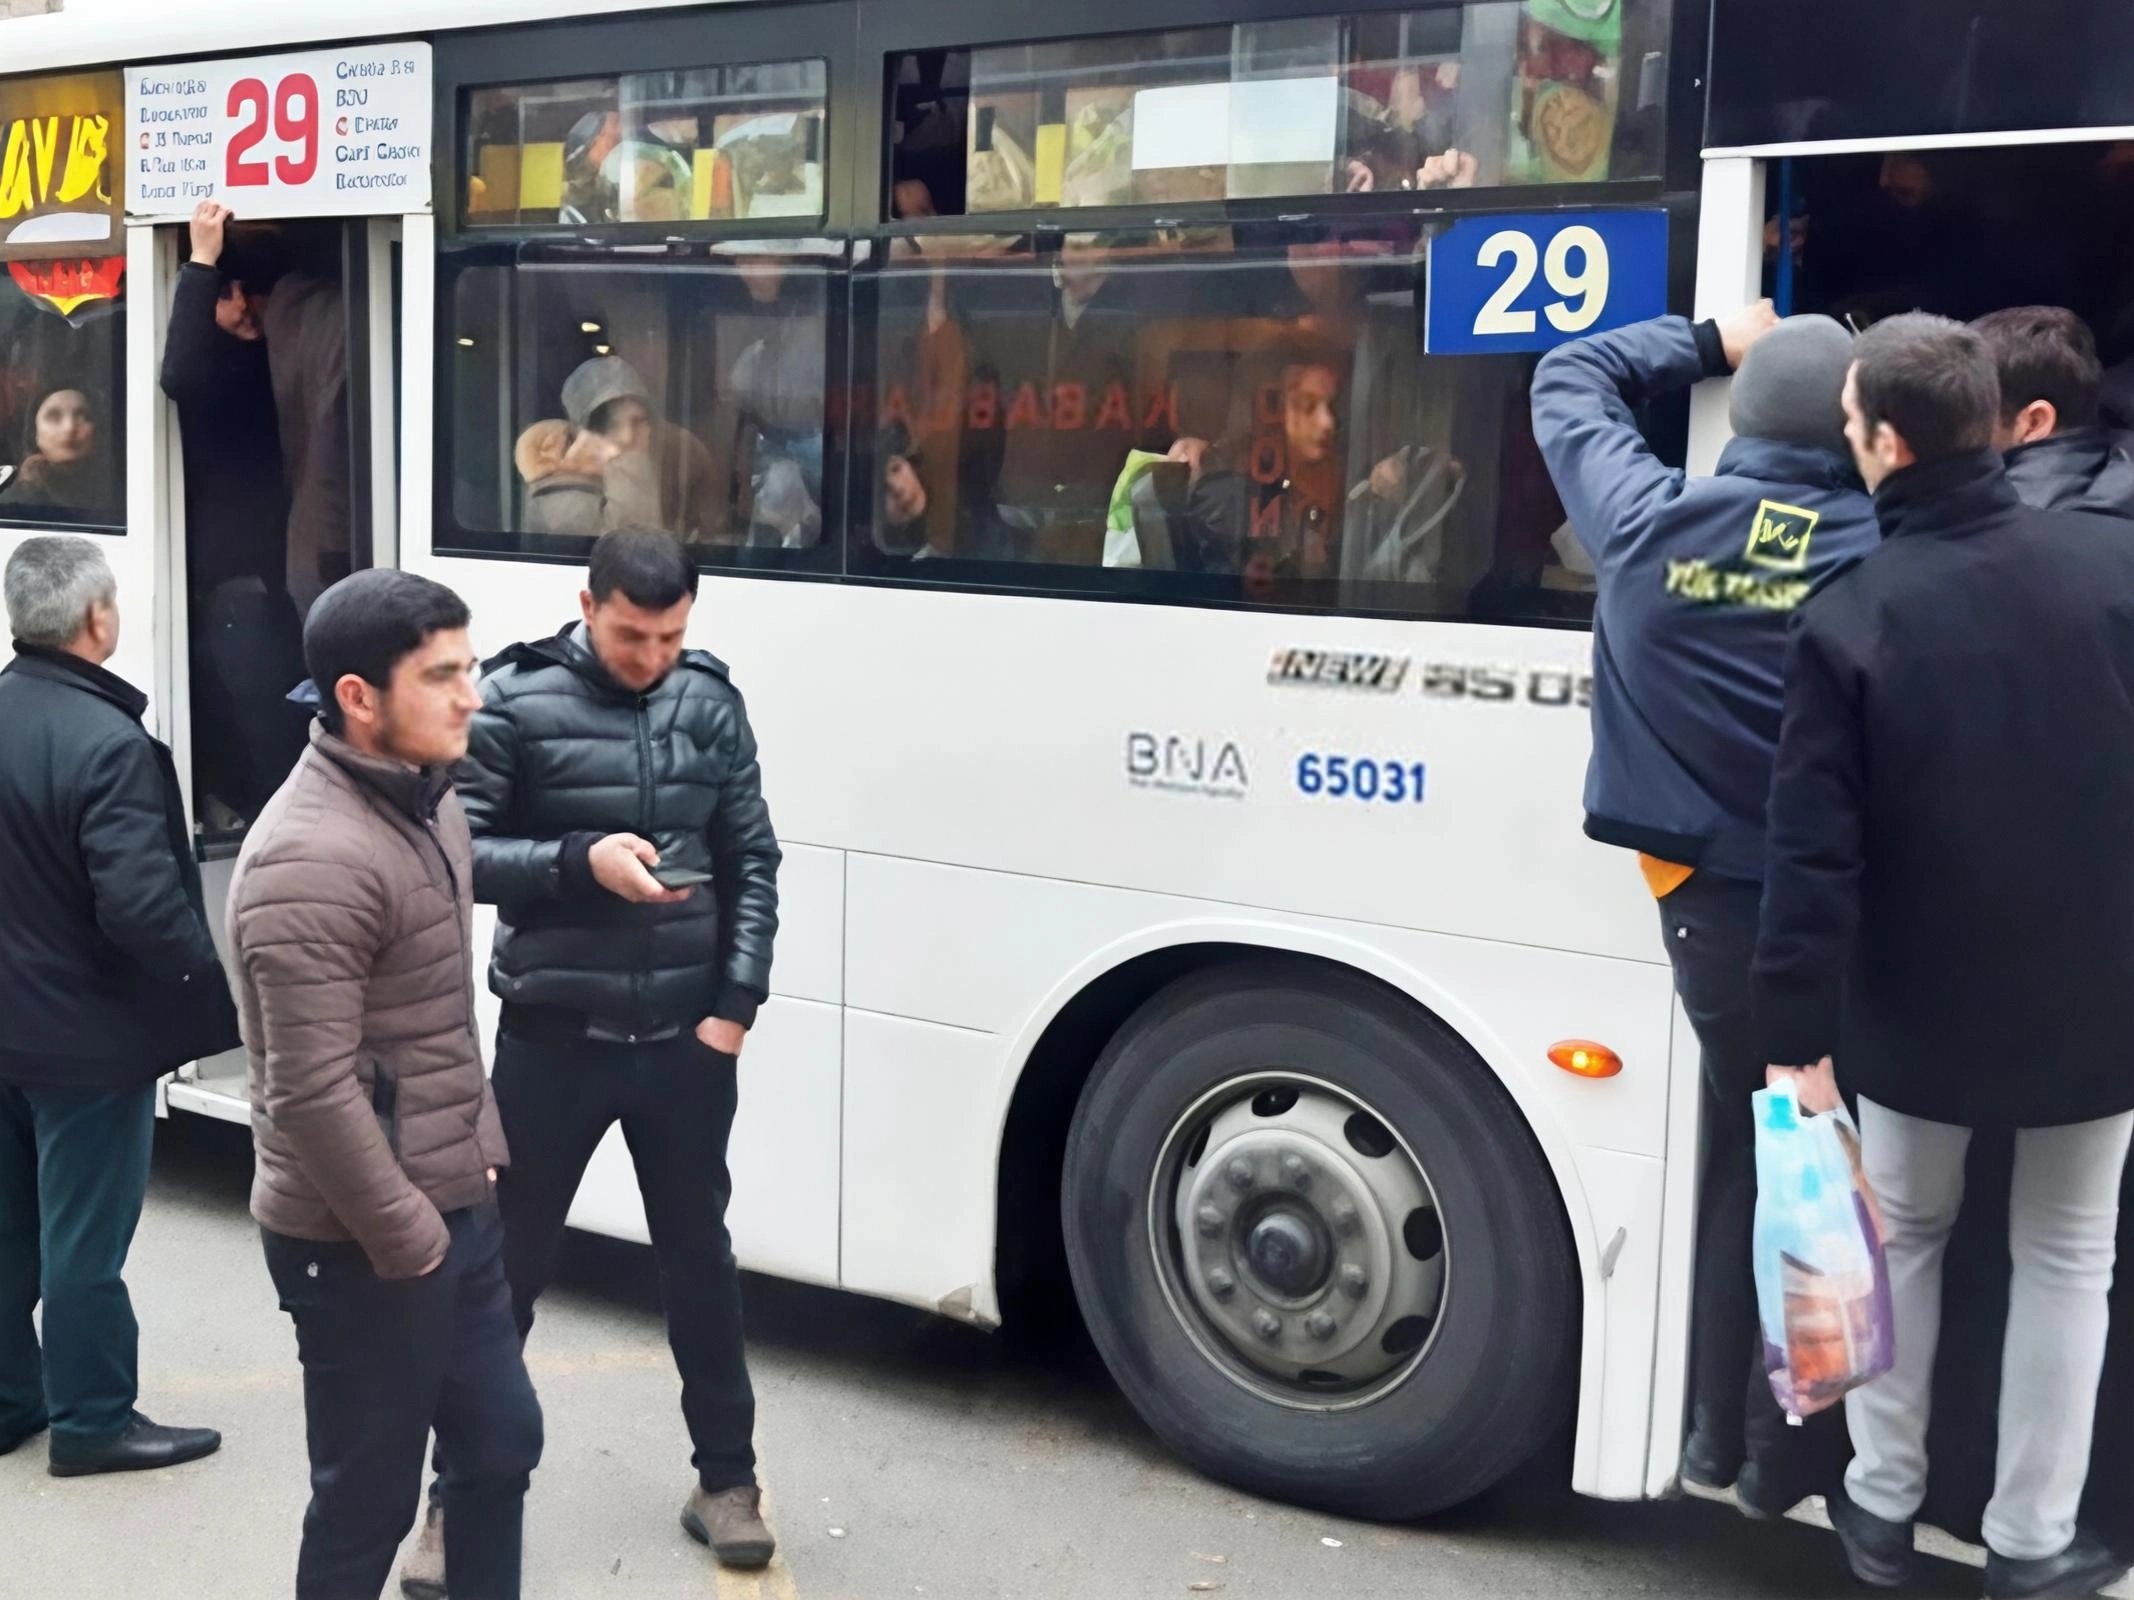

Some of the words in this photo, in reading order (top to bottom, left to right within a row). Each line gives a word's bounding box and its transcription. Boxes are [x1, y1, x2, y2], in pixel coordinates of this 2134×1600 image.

[225, 73, 319, 188] 29
[1472, 225, 1609, 335] 29
[1127, 732, 1248, 786] BNA
[1296, 752, 1426, 803] 65031
